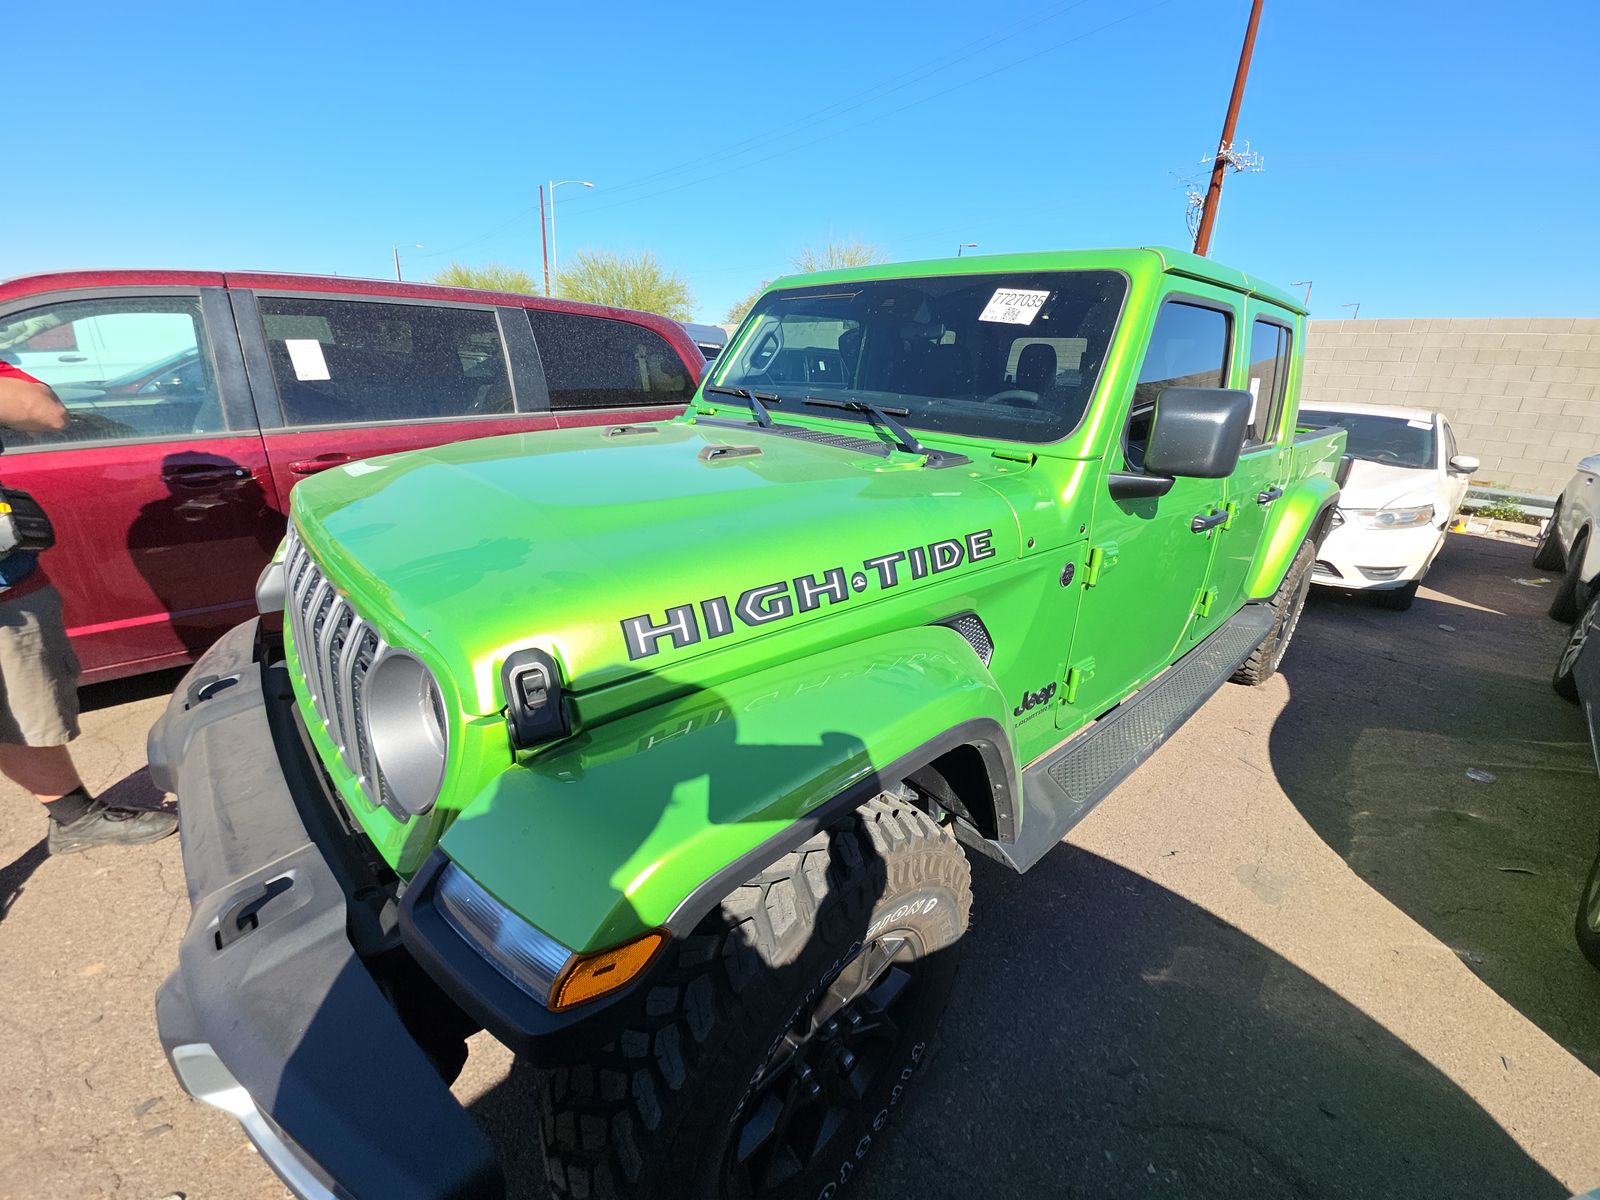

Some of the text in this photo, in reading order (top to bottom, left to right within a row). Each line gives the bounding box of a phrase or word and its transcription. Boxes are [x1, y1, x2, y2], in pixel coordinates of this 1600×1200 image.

[992, 292, 1046, 308] 7727035
[620, 529, 996, 662] HIGH TIDE
[1013, 681, 1057, 717] Jeep
